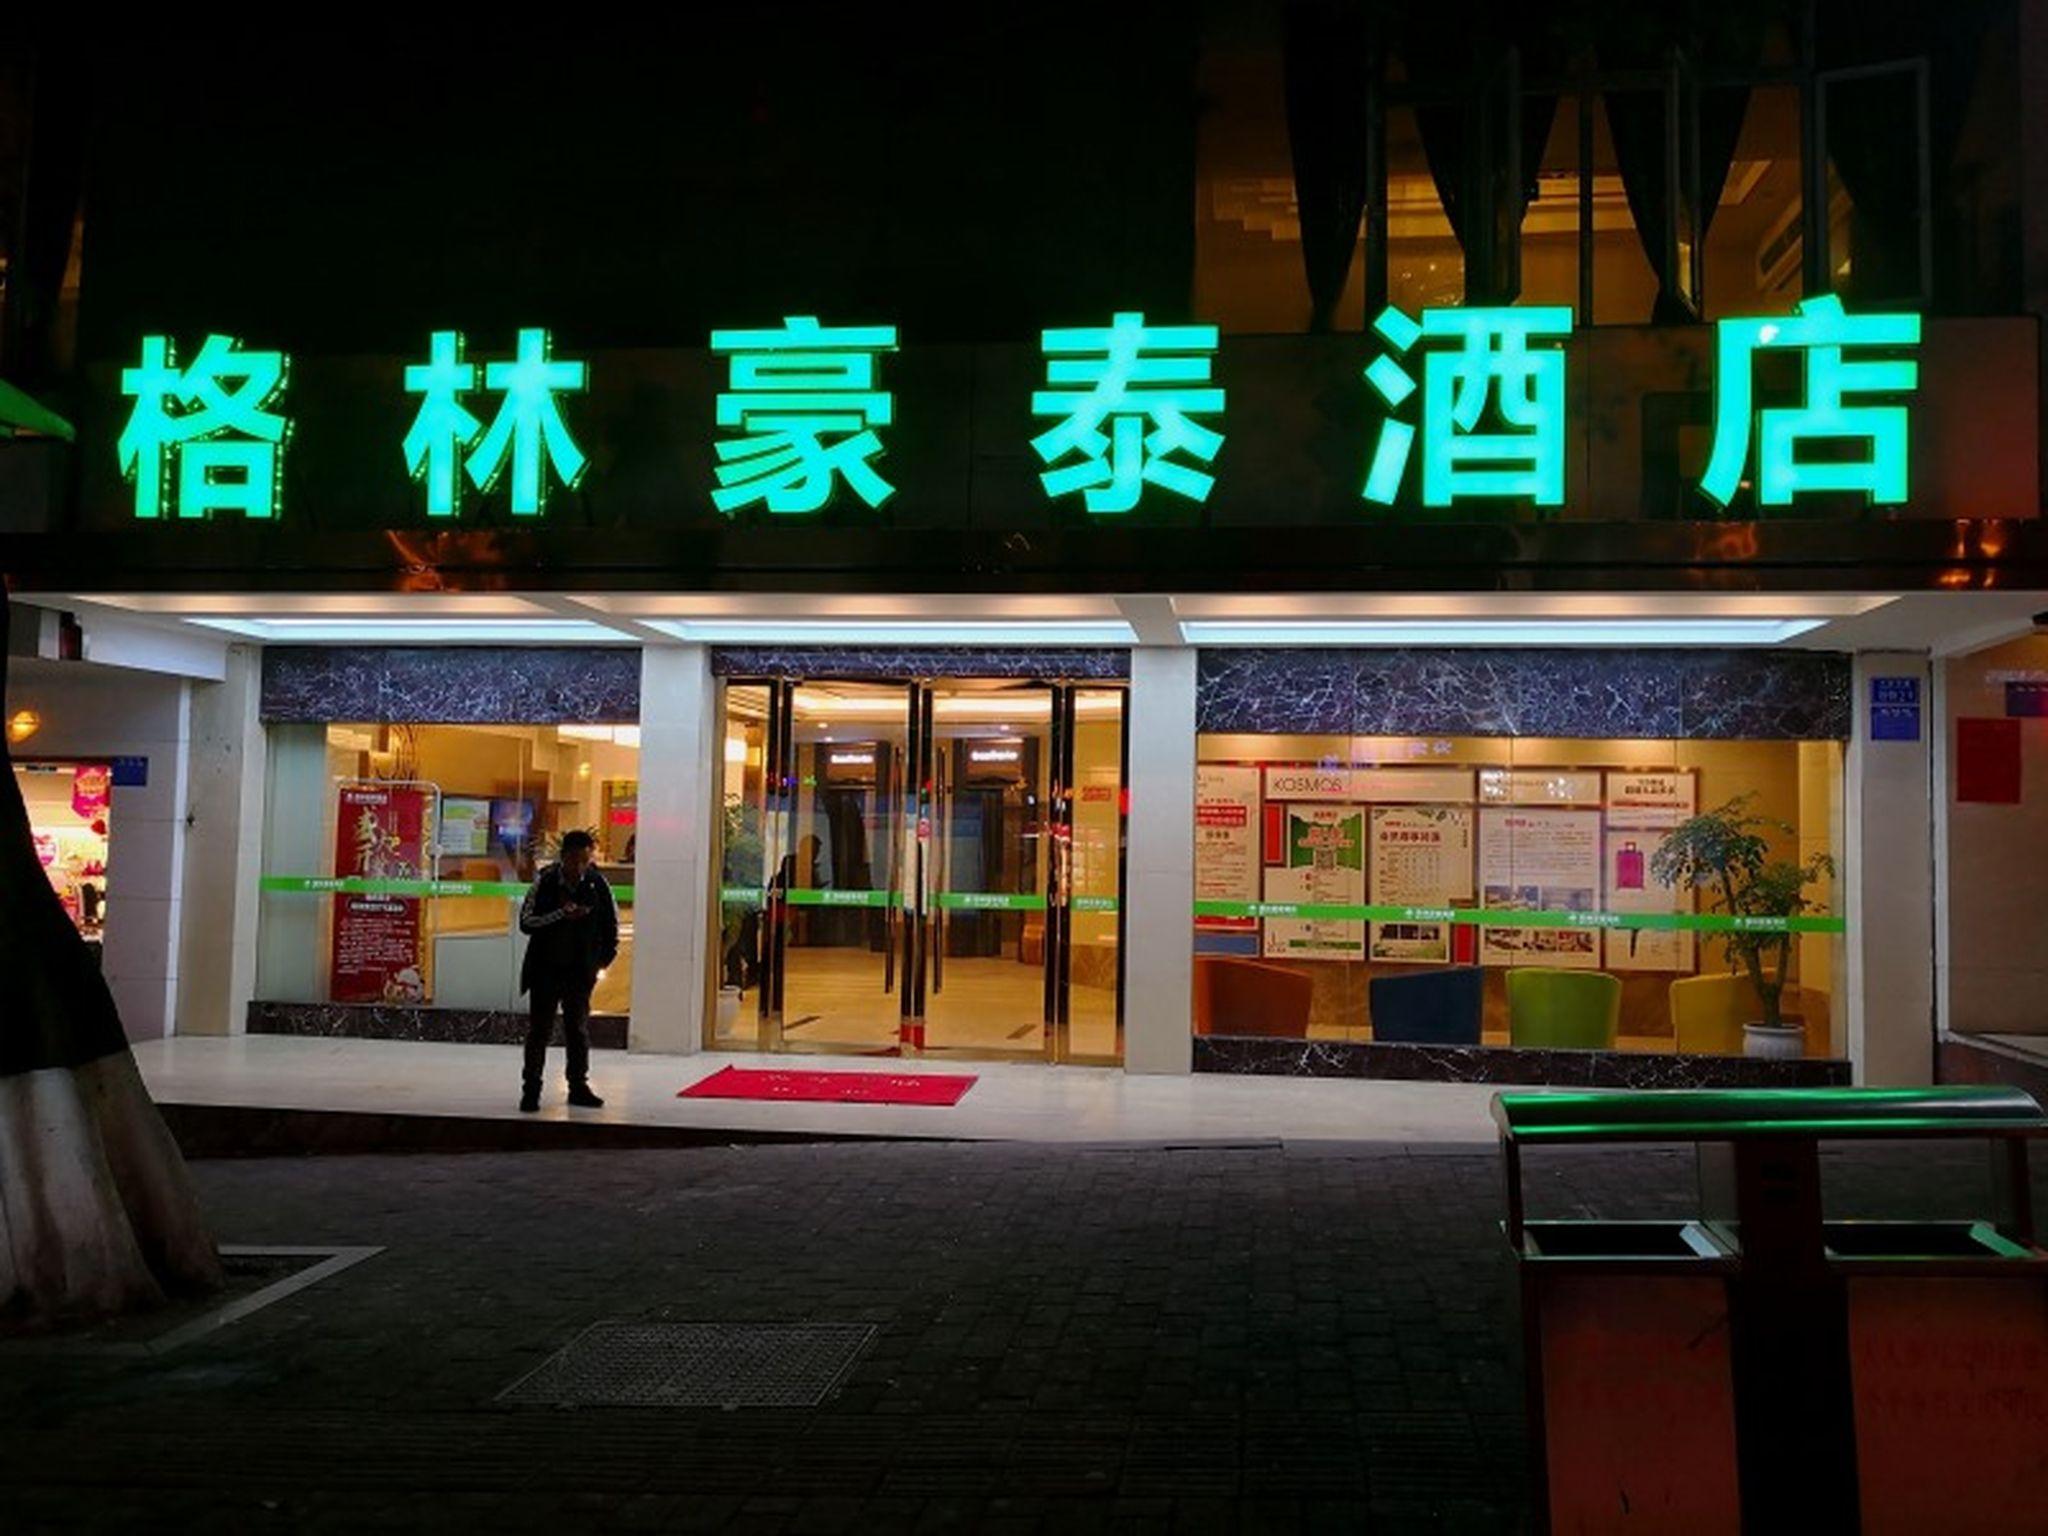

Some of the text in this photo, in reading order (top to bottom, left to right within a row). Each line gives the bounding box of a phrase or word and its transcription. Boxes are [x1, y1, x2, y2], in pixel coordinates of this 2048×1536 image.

[117, 294, 1922, 518] 格林豪泰酒店
